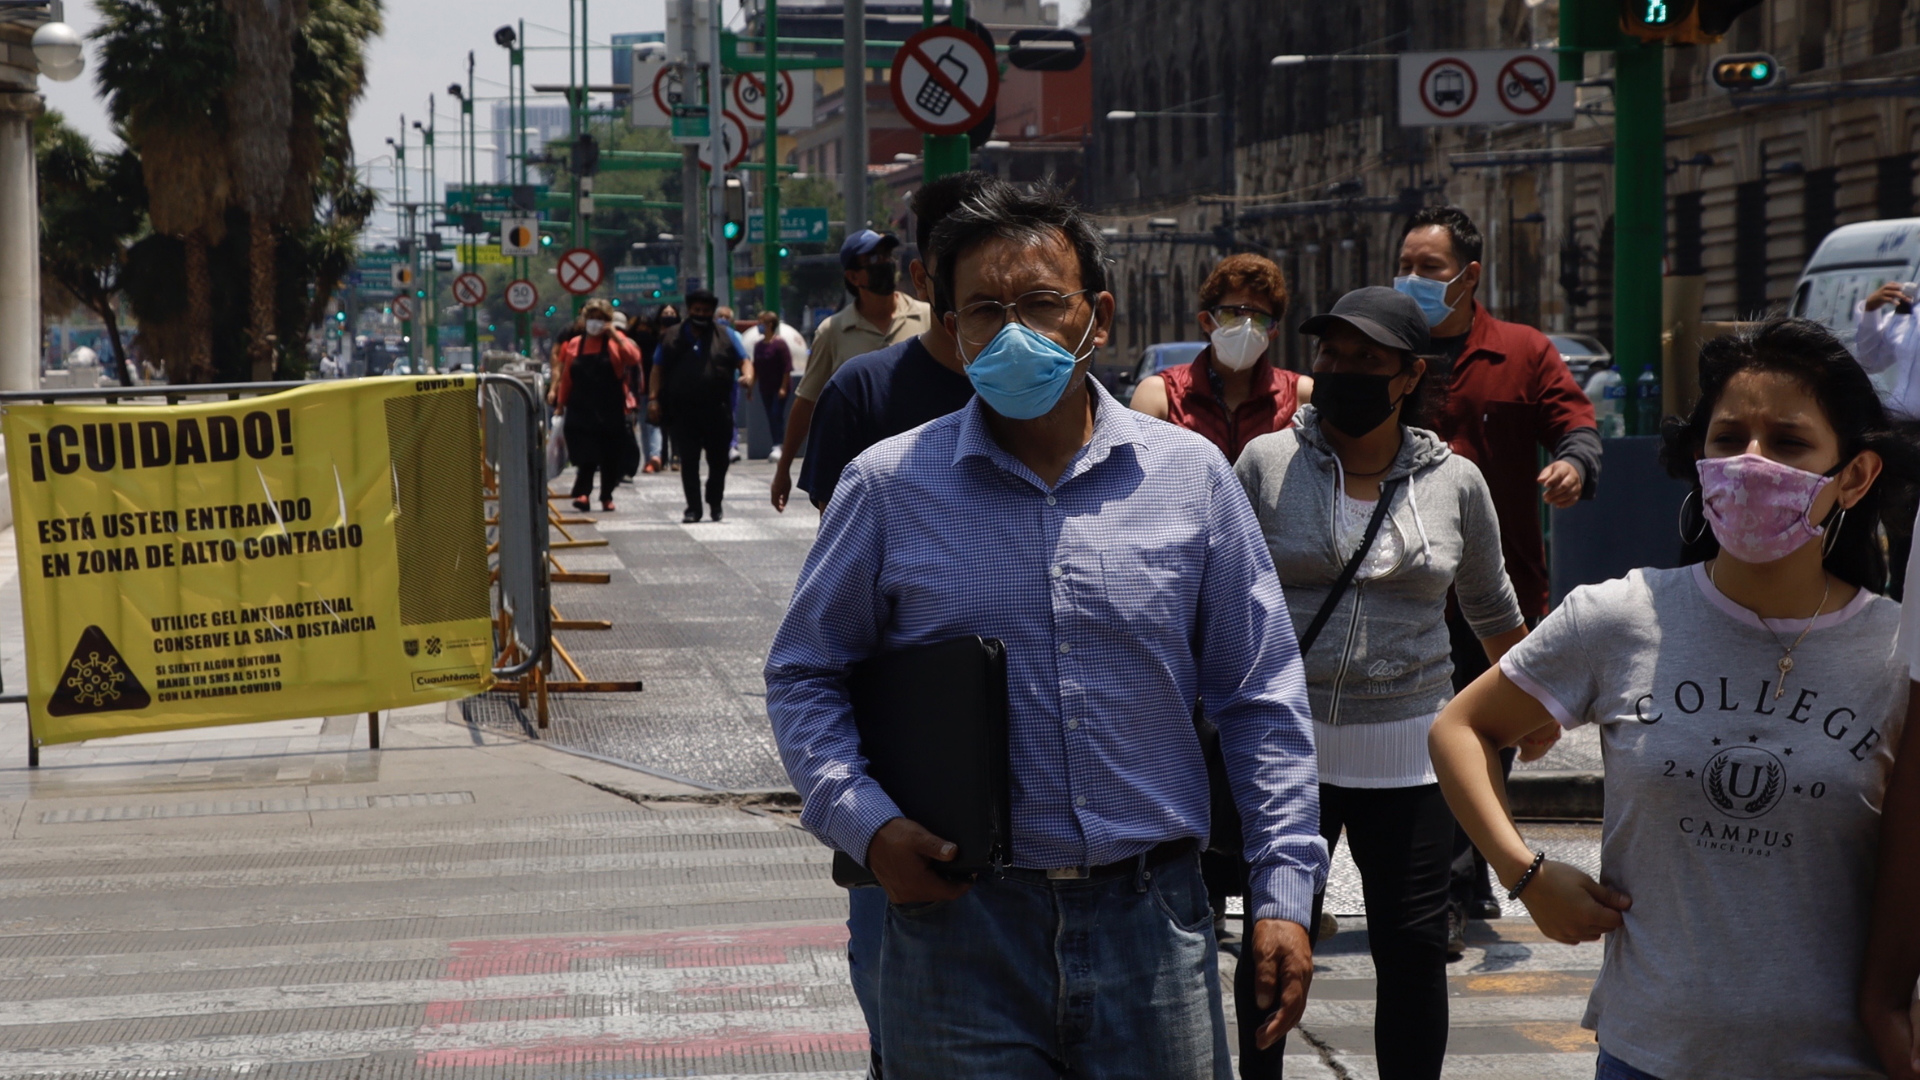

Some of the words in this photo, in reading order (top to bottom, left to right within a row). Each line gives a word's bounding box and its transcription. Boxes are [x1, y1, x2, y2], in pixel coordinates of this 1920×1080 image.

[415, 378, 465, 392] COVID-19
[28, 408, 294, 482] ¡CUIDADO!
[37, 511, 97, 544] ESTÁ
[102, 510, 178, 539] USTED
[185, 497, 312, 532] ENTRANDO
[41, 553, 71, 578] EN
[77, 548, 139, 575] ZONA
[145, 543, 175, 570] DE
[181, 539, 236, 566] ALTO
[243, 523, 363, 560] CONTAGIO
[151, 613, 208, 632] UTILICE
[211, 610, 237, 627] GEL
[240, 597, 354, 623] ANTIBACTERIAL
[153, 633, 231, 653] CONSERVE
[234, 630, 251, 646] LA
[254, 625, 294, 643] SANA
[296, 616, 376, 639] DISTANCIA
[155, 665, 166, 676] SI
[168, 660, 202, 674] SIENTE
[203, 657, 235, 671] ALGÚN
[237, 653, 281, 667] SÍNTOMA
[157, 677, 191, 689] MANDE
[193, 675, 207, 686] UN
[209, 671, 230, 683] SMS
[232, 670, 244, 682] AL
[246, 669, 258, 680] 51
[259, 668, 272, 679] 51
[273, 667, 280, 678] 5
[416, 672, 481, 685] Cuauhtémoc
[158, 690, 178, 702] CON
[181, 688, 192, 700] LA
[194, 685, 238, 698] PALABRA
[240, 681, 282, 694] COVID19
[1635, 677, 1881, 761] COLLEGE
[1663, 760, 1676, 777] 2
[1728, 762, 1764, 798] U
[1679, 817, 1794, 848] CAMPUS
[1696, 838, 1736, 853] SINCE
